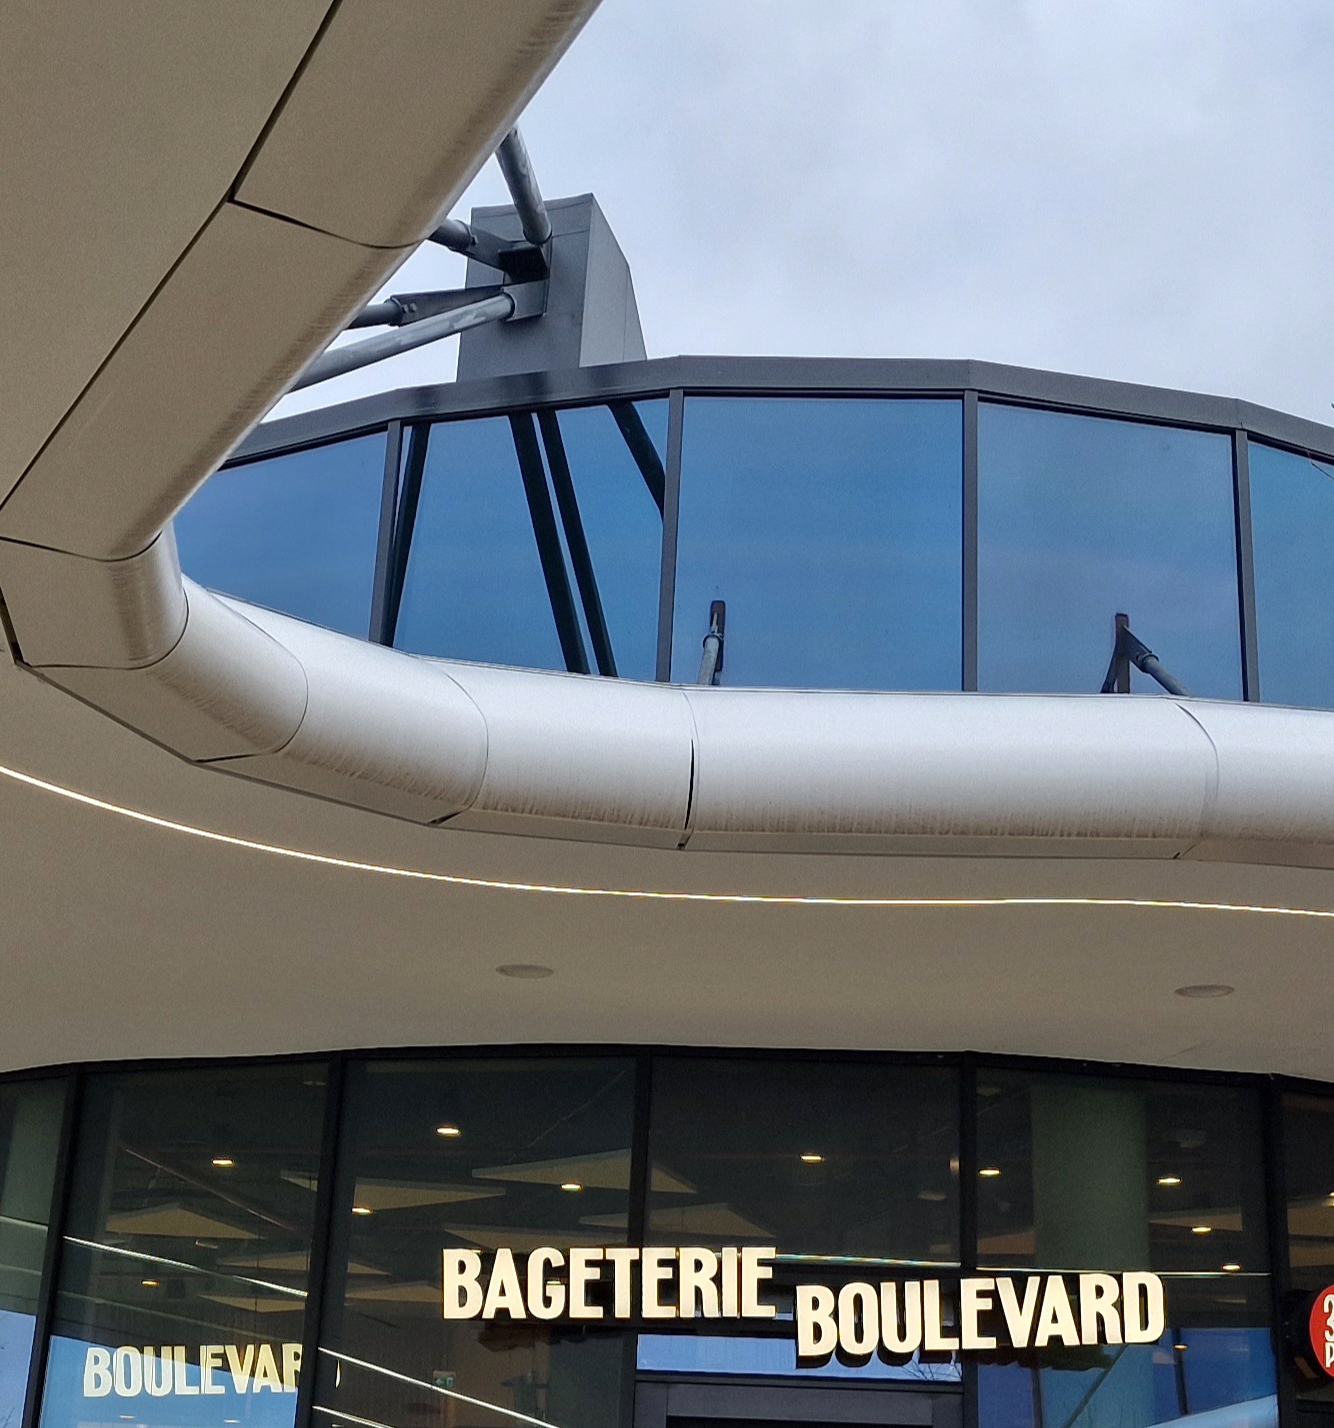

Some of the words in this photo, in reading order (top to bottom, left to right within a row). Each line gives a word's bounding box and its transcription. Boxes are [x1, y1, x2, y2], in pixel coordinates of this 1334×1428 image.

[442, 1247, 777, 1320] BAGETERIE
[796, 1271, 1165, 1356] BOULEVARD
[83, 1343, 304, 1397] BOULEVAR
